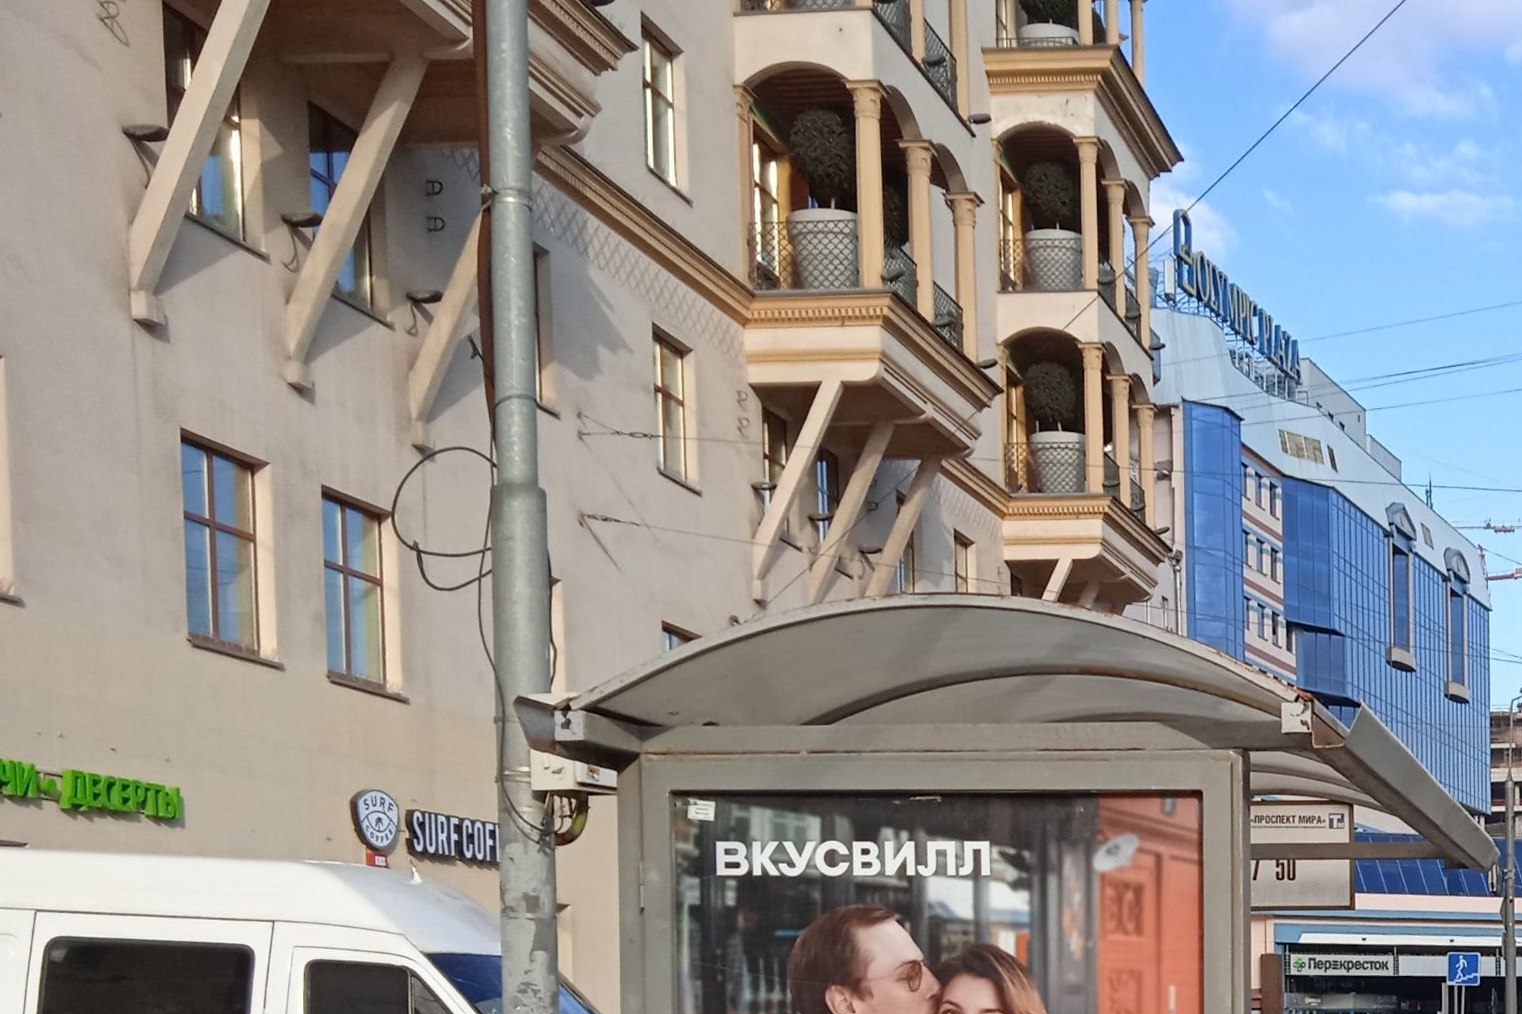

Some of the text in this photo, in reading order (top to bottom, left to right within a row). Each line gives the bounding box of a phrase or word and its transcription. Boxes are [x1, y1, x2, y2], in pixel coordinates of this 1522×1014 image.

[60, 769, 181, 819] ДЕСЕРТЫ
[363, 794, 395, 814] SURF
[413, 810, 459, 857] SURF
[715, 839, 992, 877] ВКУСВИЛЛ
[1308, 957, 1389, 972] Перекресток
